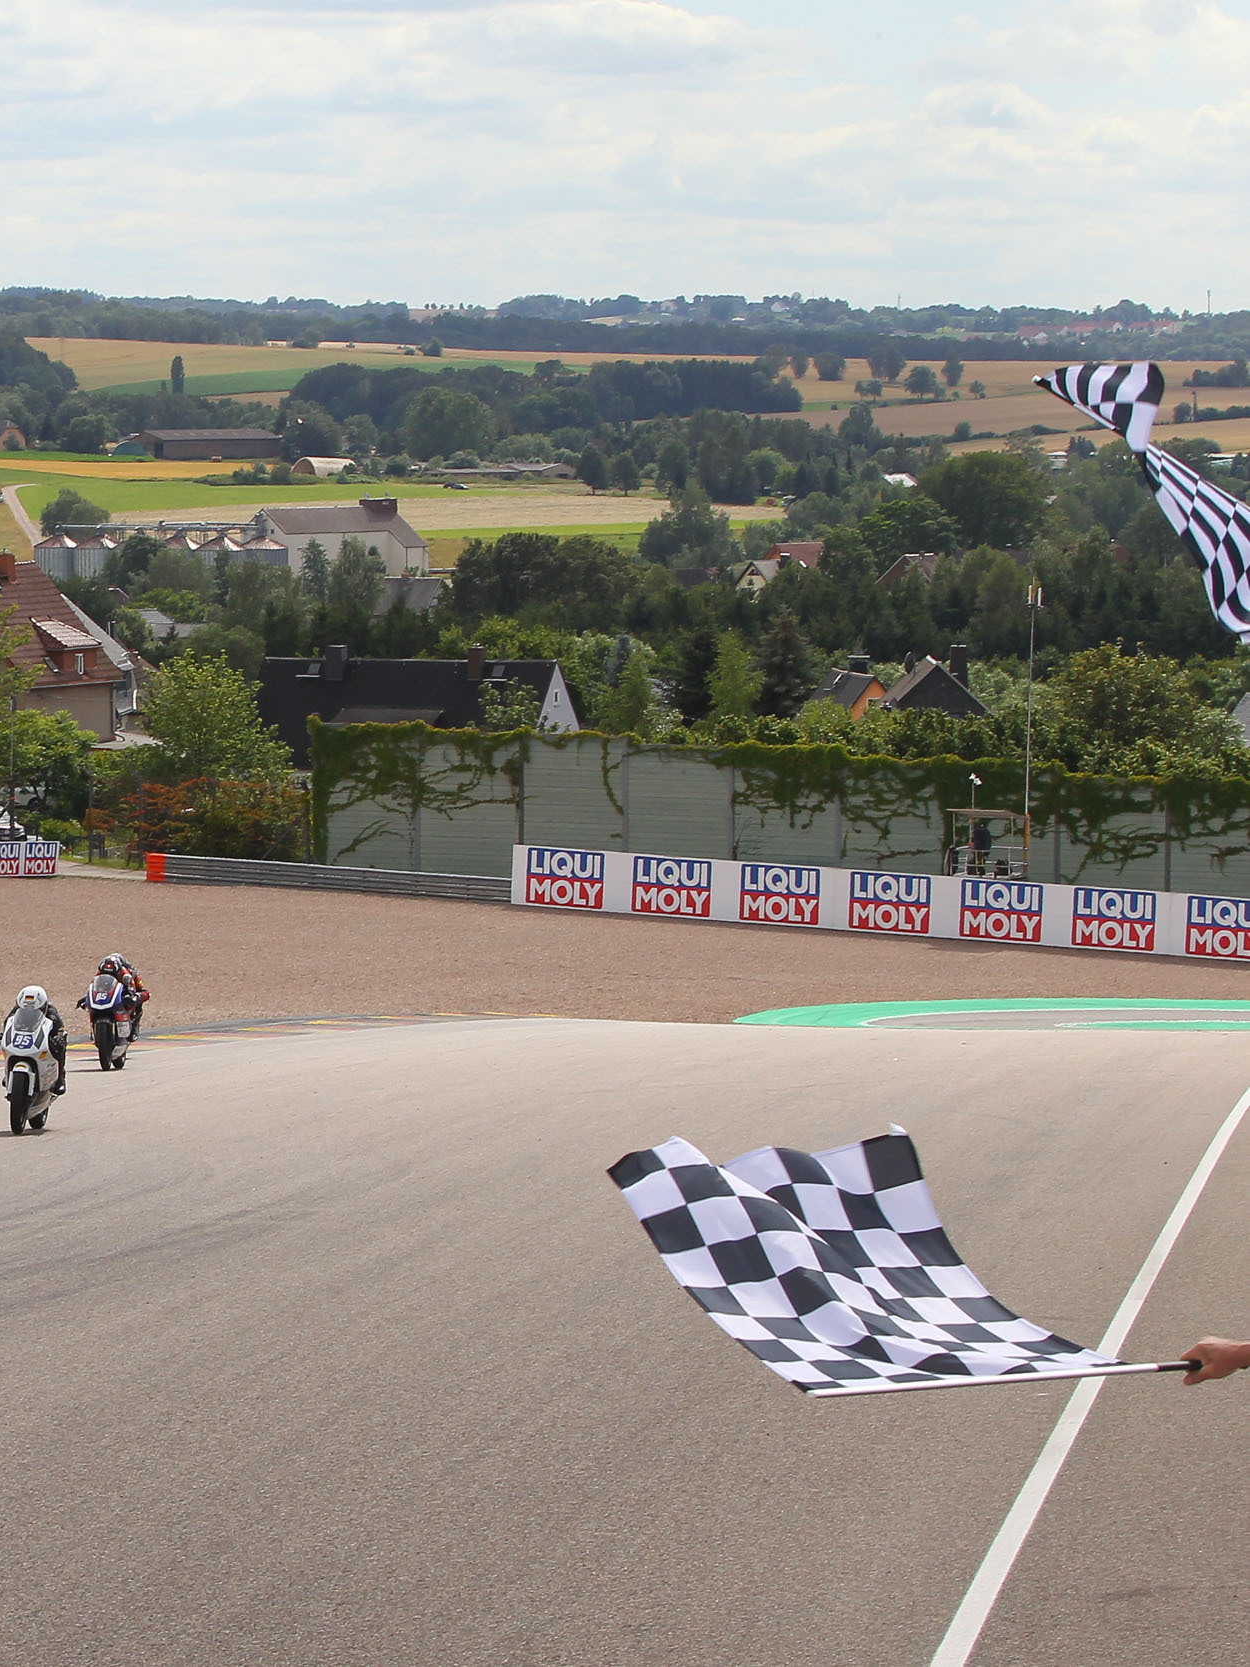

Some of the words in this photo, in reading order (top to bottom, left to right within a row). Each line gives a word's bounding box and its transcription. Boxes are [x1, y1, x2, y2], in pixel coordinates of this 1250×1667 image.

[27, 843, 56, 859] LIQUI
[531, 850, 601, 879] LIQUI
[26, 858, 55, 874] MOLY
[637, 858, 708, 887] LIQUI
[529, 878, 602, 906] MOLY
[745, 866, 817, 895] LIQUI
[855, 874, 928, 903] LIQUI
[634, 887, 709, 914] MOLY
[743, 894, 818, 922] MOLY
[965, 882, 1040, 912] LIQUI
[1078, 890, 1153, 921] LIQUI
[852, 902, 929, 930] MOLY
[963, 911, 1040, 939] MOLY
[1191, 899, 1250, 928] LIQU
[1075, 919, 1154, 948] MOLY
[1189, 929, 1250, 954] MOL
[14, 1036, 31, 1046] 95
